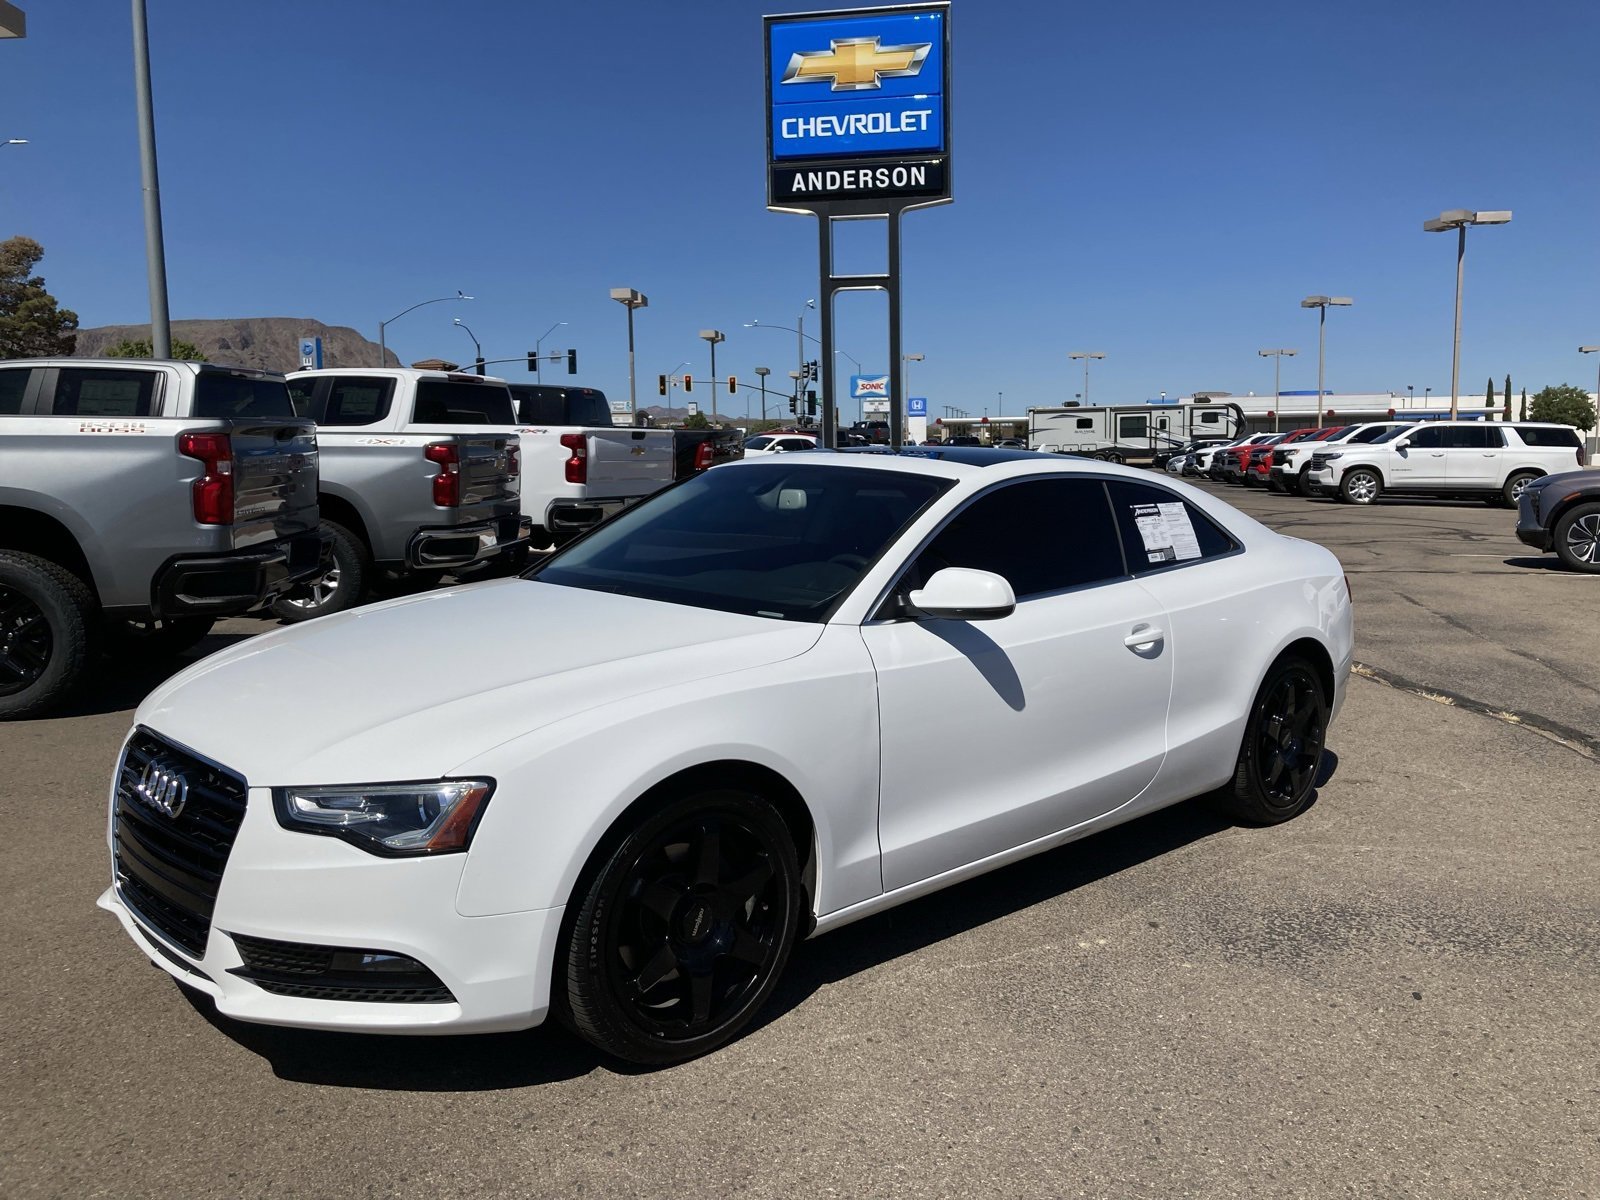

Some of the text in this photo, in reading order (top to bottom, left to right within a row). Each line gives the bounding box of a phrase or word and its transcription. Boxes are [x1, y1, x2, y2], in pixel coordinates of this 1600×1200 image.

[781, 109, 932, 139] CHEVROLET
[791, 166, 926, 192] ANDERSON
[860, 382, 884, 390] SONIC
[589, 889, 606, 969] Fireston
